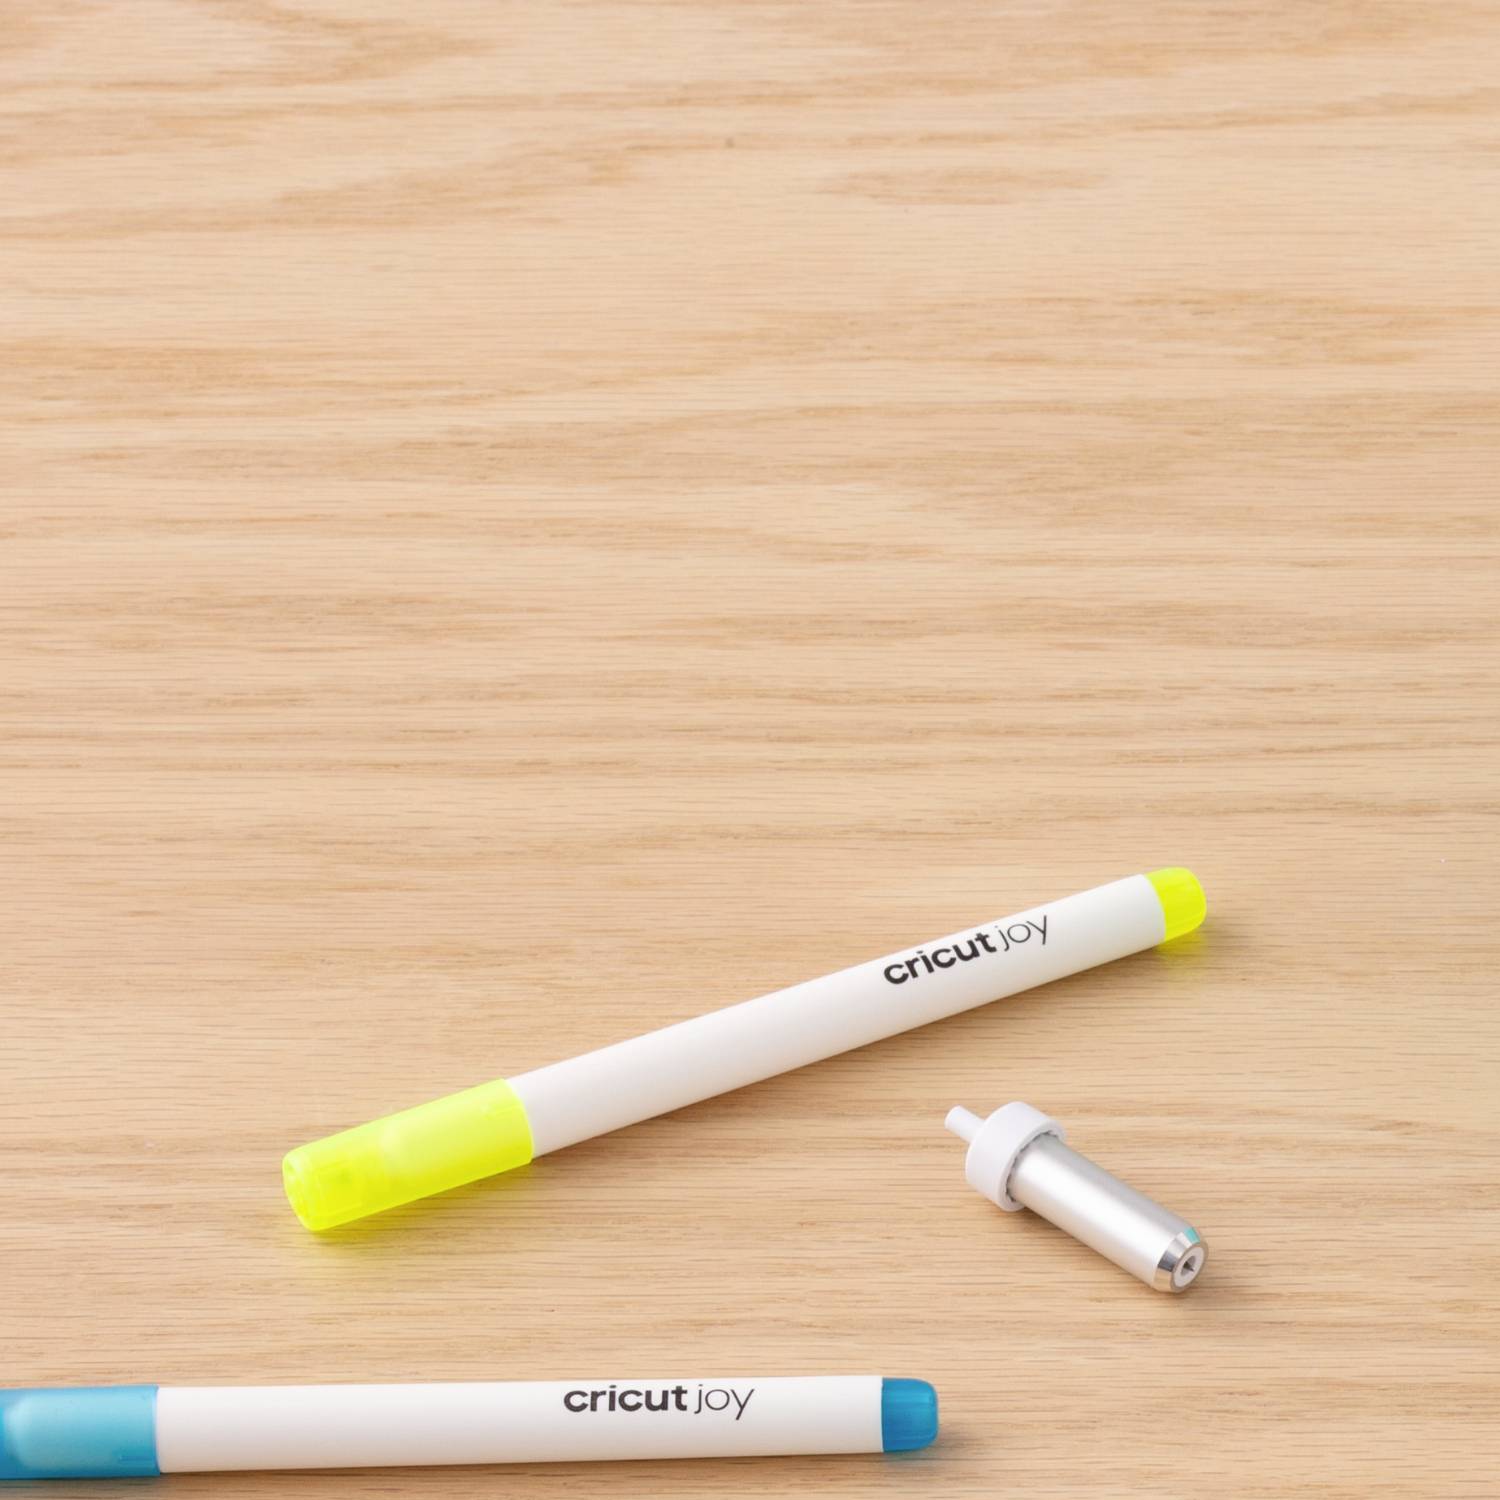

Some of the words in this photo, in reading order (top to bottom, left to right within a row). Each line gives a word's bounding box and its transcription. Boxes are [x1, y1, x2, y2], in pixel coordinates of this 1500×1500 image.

[883, 932, 998, 985] cricut
[993, 915, 1048, 952] joy
[563, 1385, 688, 1412] cricut
[694, 1384, 755, 1421] joy
